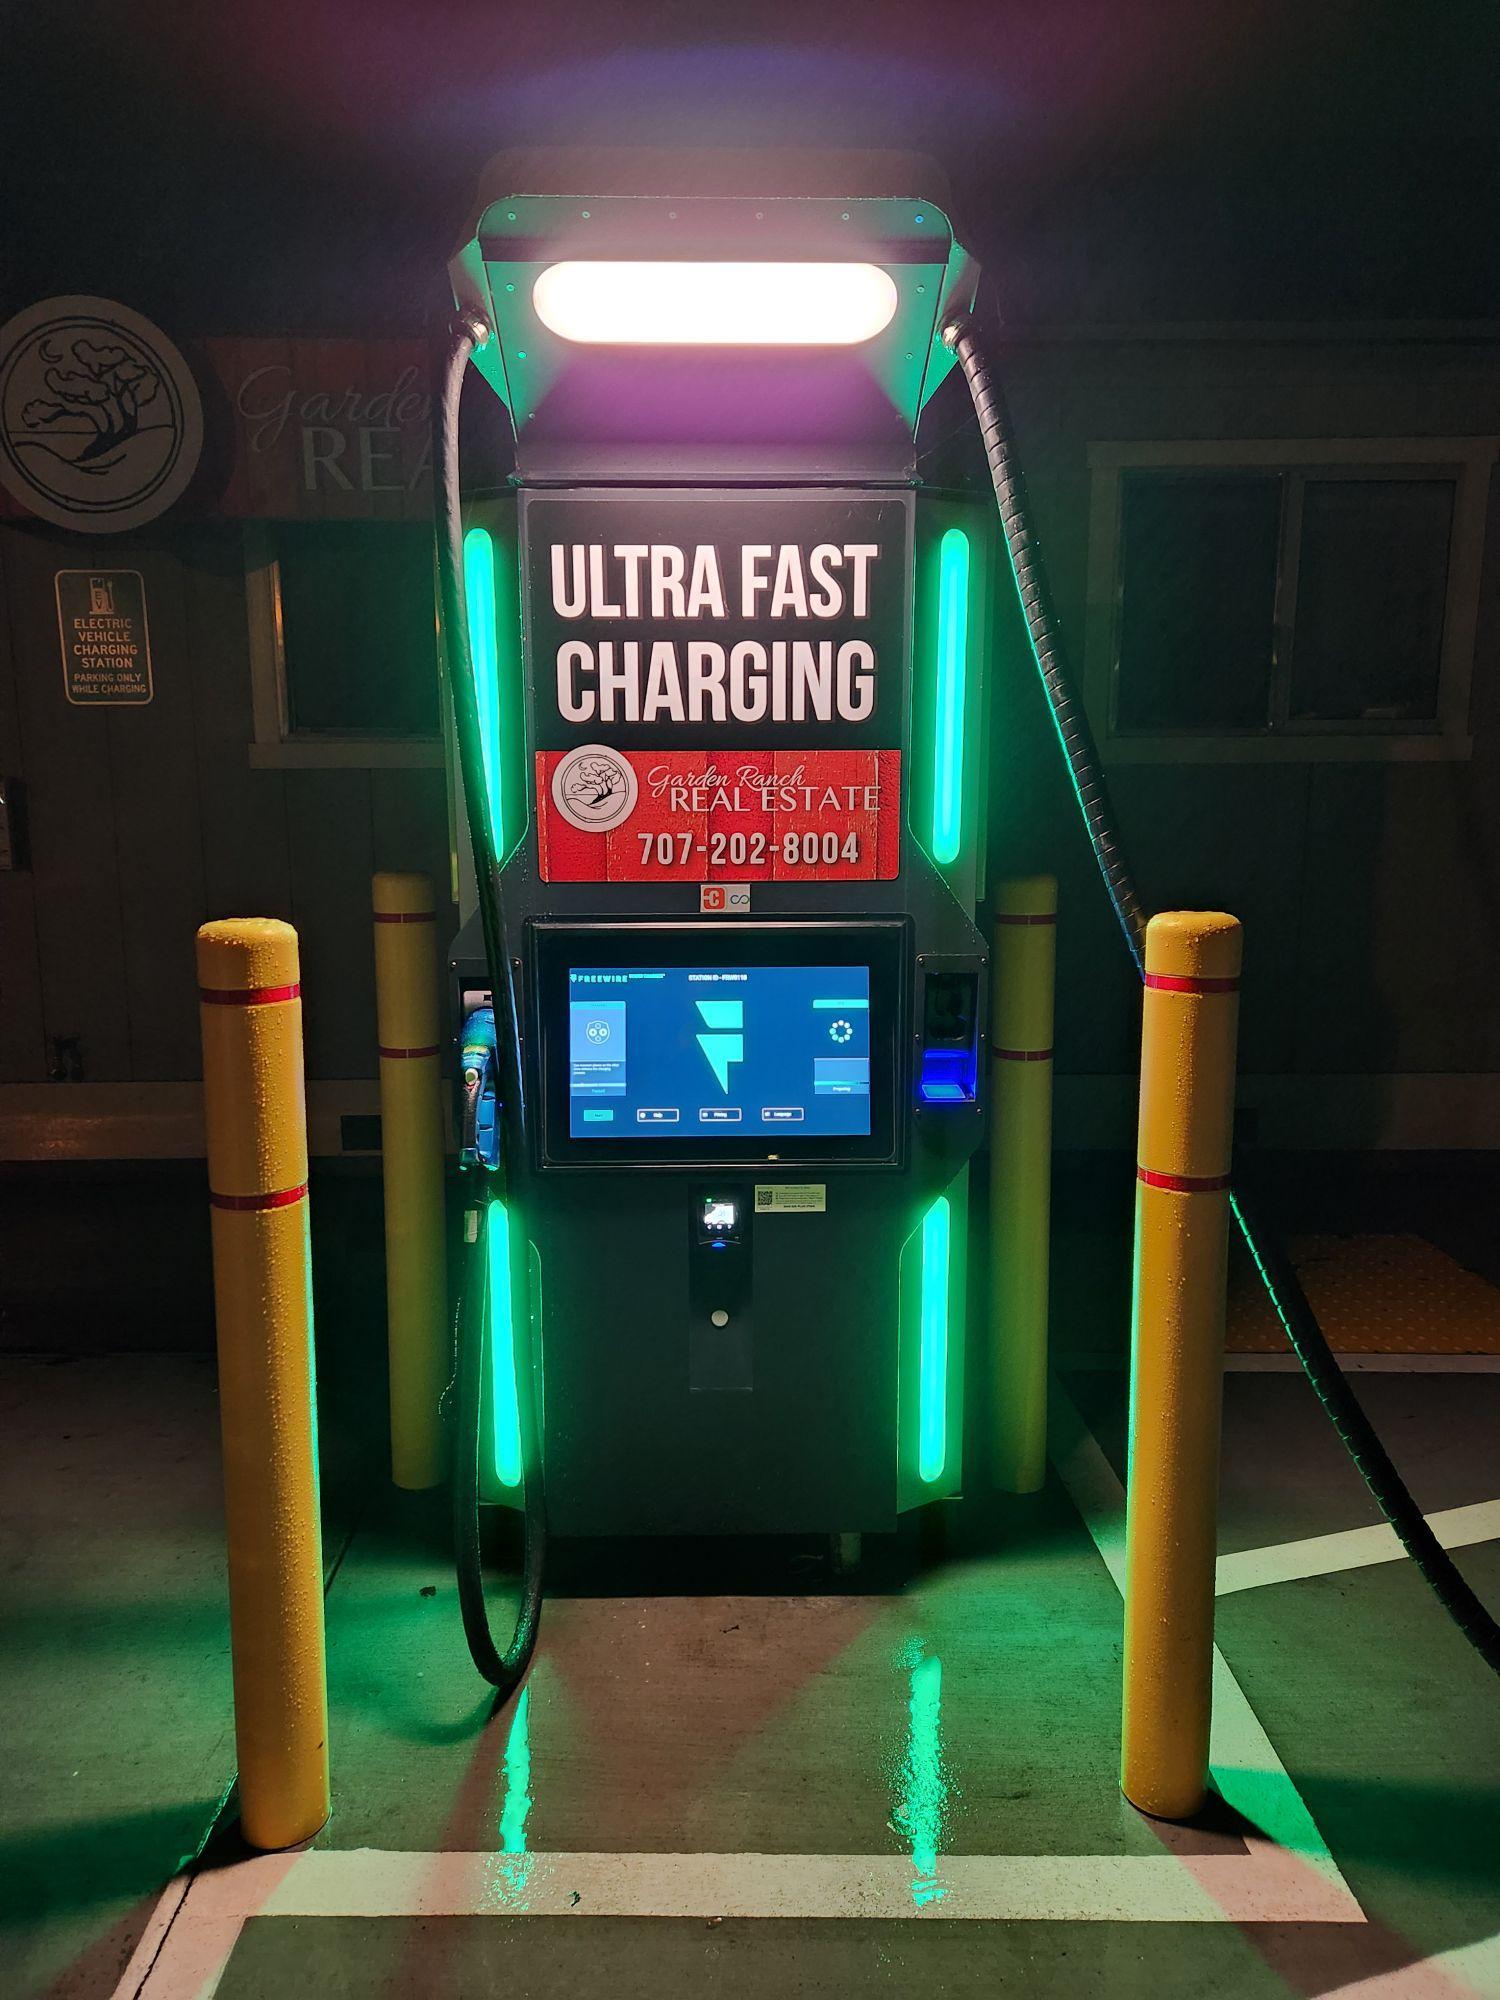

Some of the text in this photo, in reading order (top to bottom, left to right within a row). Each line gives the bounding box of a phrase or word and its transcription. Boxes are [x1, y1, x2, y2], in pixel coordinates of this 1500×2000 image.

[550, 543, 879, 619] ULTRA FAST
[73, 618, 133, 629] ELECTRIC
[78, 631, 131, 642] VEHICLE
[73, 644, 138, 655] CHARGING
[81, 657, 133, 668] STATION
[74, 673, 142, 682] PARKING ONLY
[556, 640, 876, 723] CHARGING
[72, 684, 147, 694] WHILE CHARGING
[647, 765, 806, 797] Garden Ranch
[670, 786, 882, 812] REAL ESTATE
[637, 832, 859, 865] 707-202-8004
[578, 975, 628, 983] FREEWIRE
